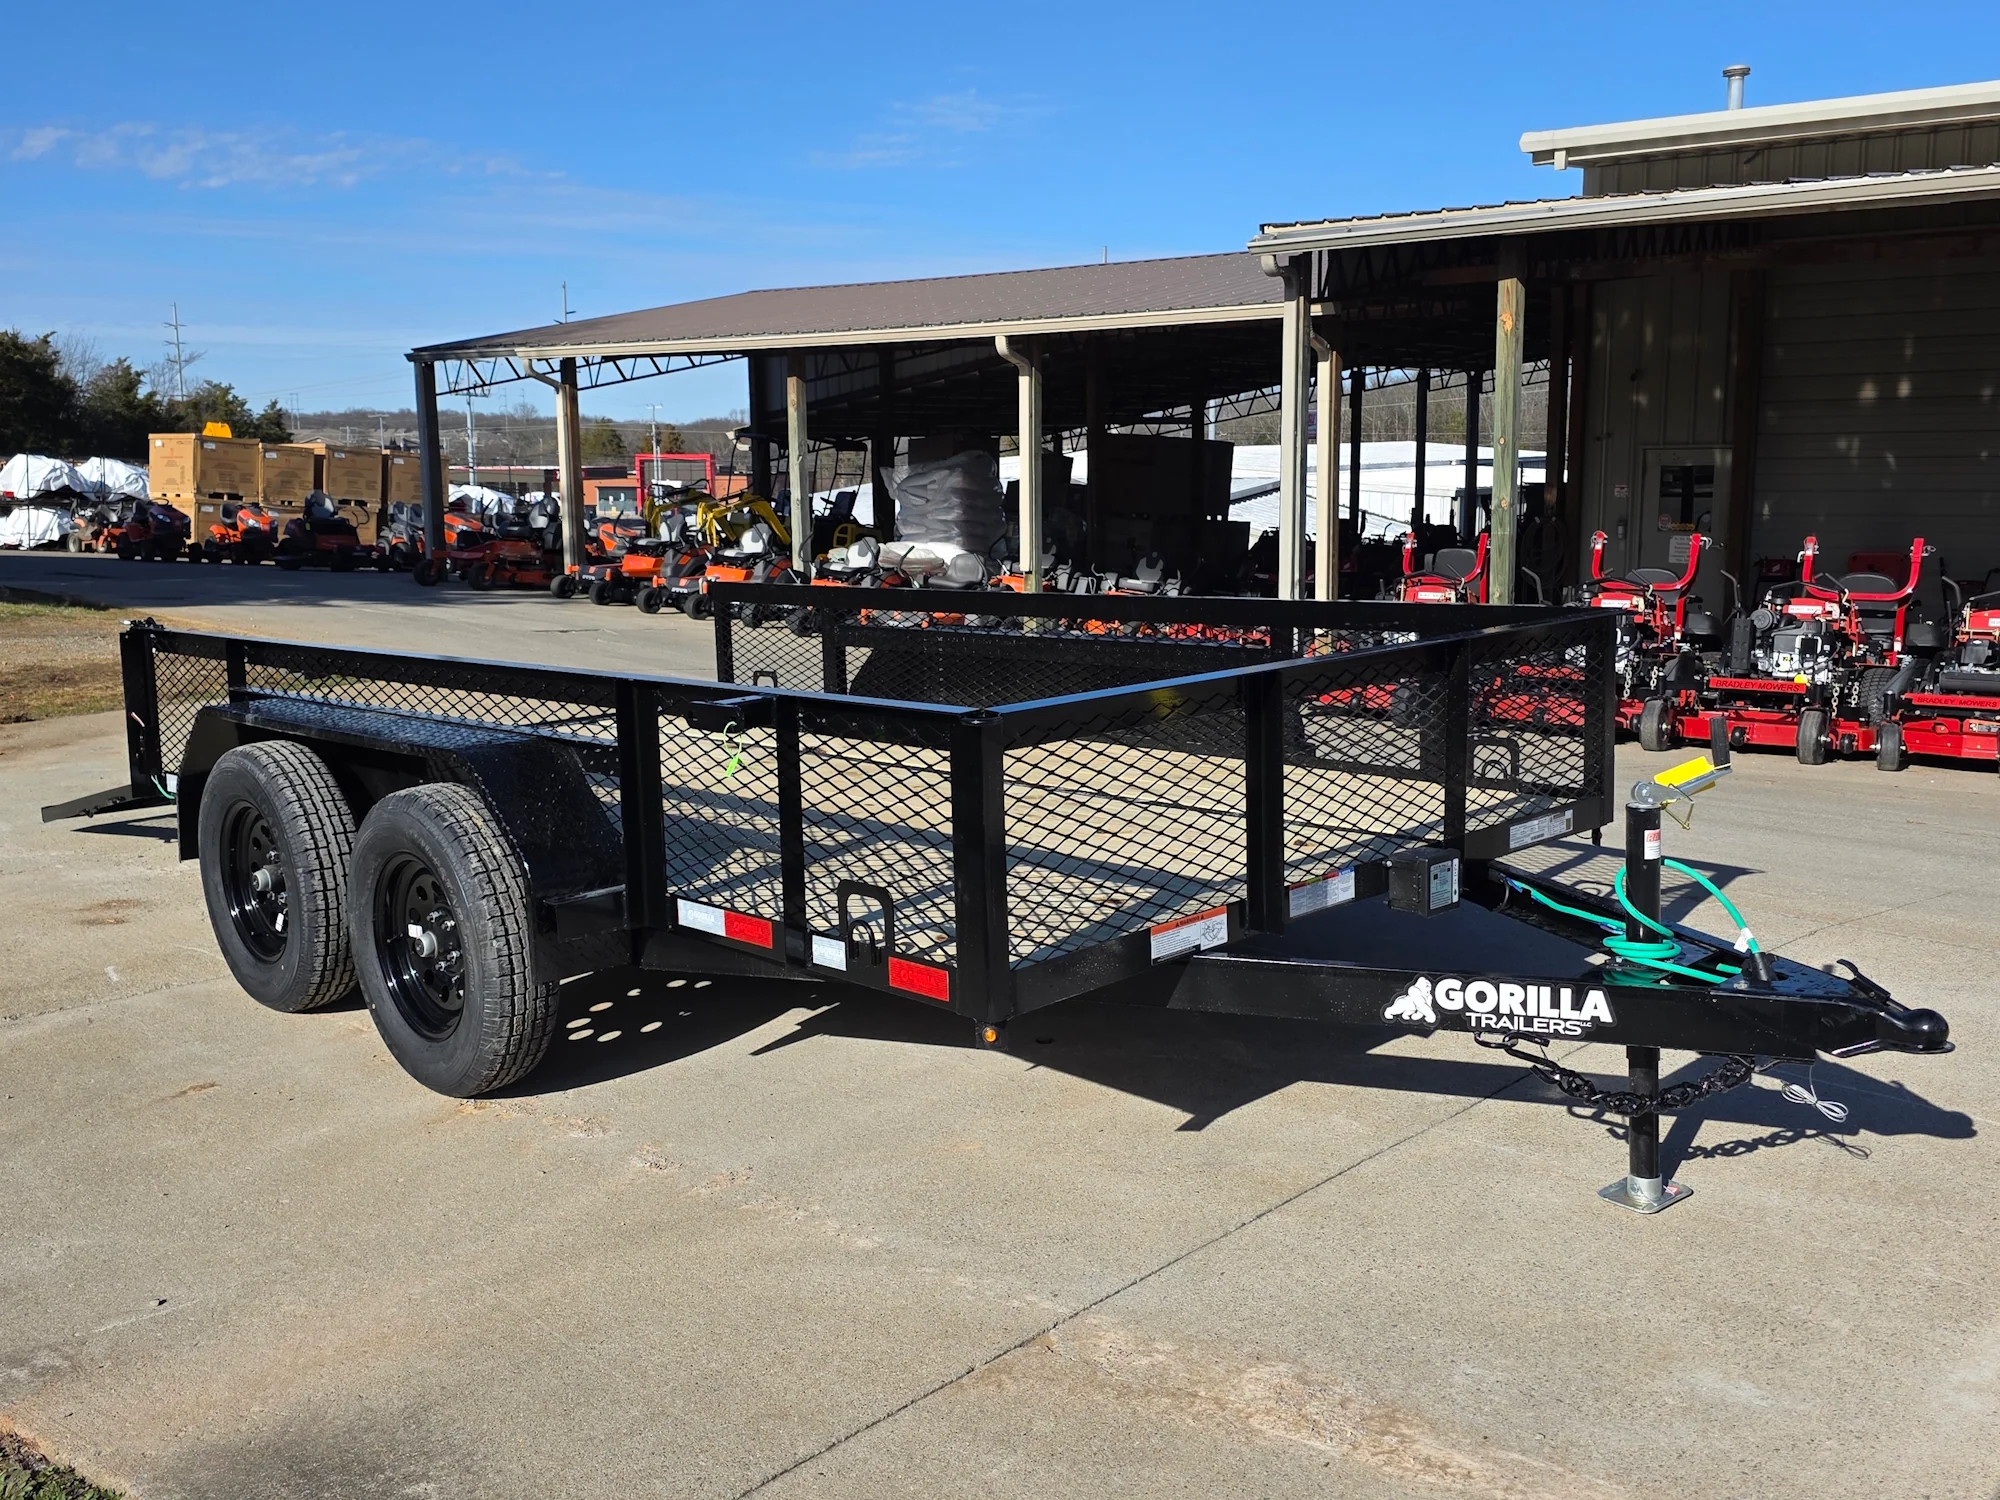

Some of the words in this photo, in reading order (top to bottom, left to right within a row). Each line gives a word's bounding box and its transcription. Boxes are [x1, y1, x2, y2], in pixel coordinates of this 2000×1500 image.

[1715, 680, 1757, 690] BRADLEY
[1758, 683, 1800, 692] MOWERS
[1917, 697, 1955, 705] BRADLEY
[1958, 700, 1998, 708] MOWERS
[1435, 978, 1613, 1023] GORILLA
[1465, 1012, 1582, 1036] TRAILERS
